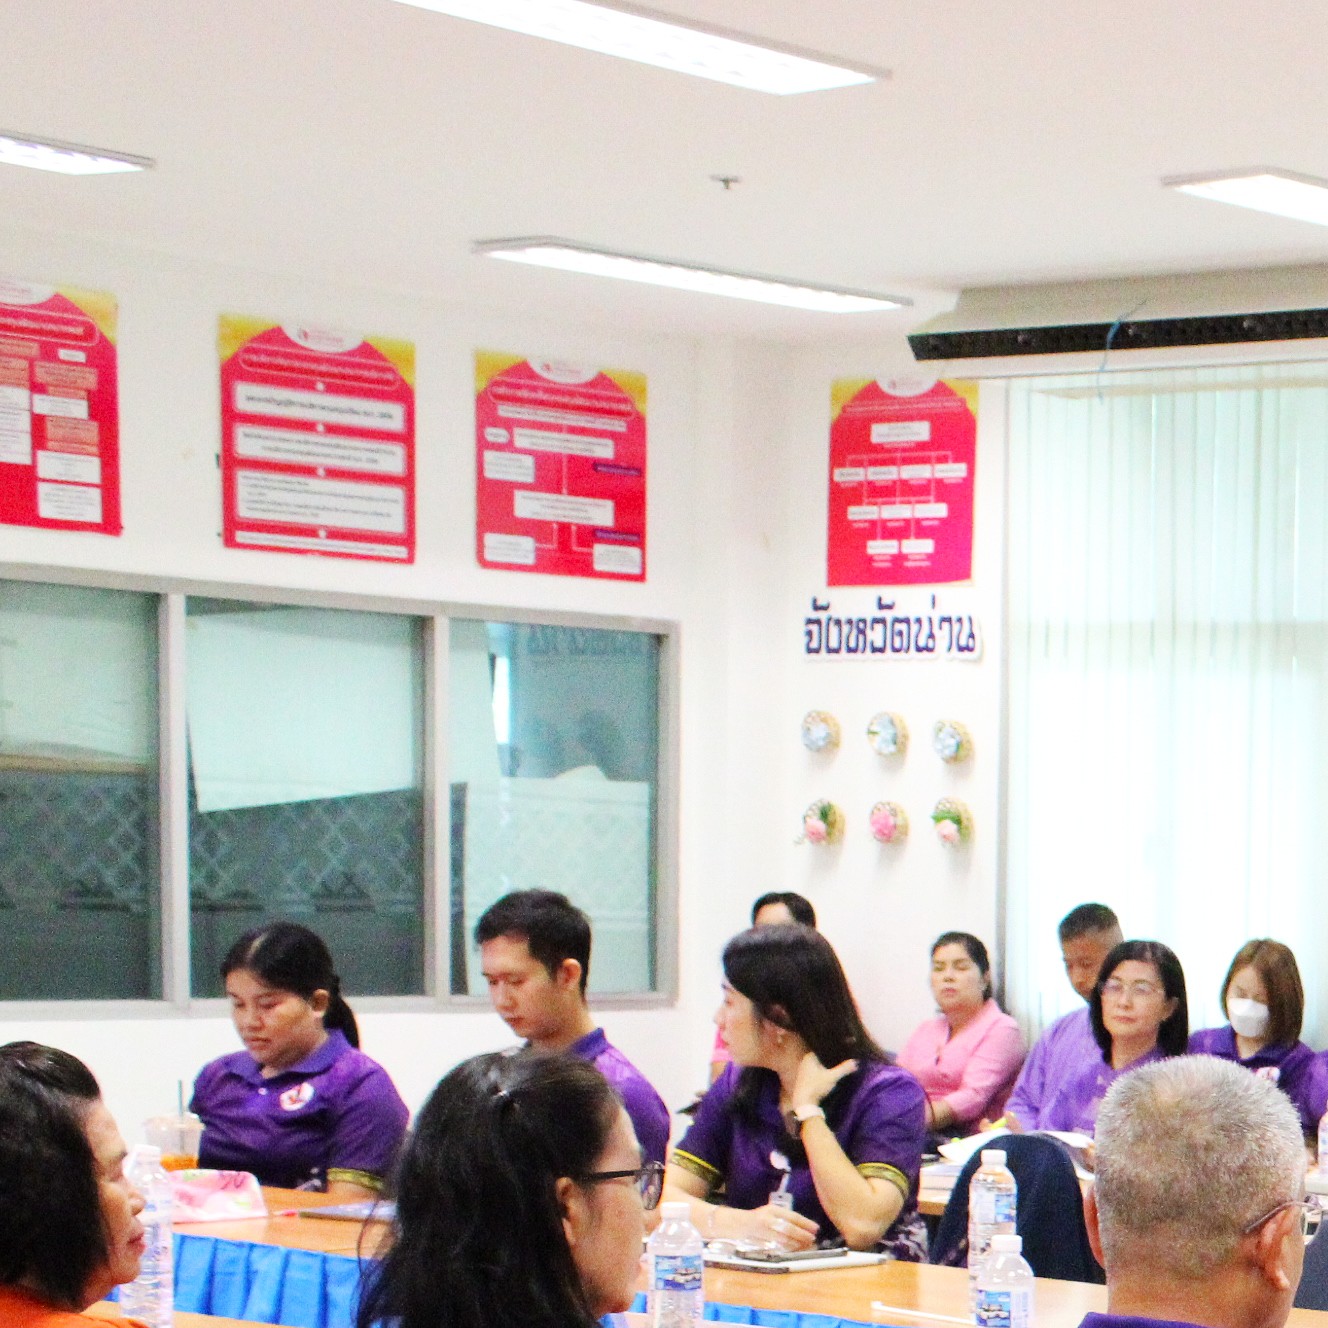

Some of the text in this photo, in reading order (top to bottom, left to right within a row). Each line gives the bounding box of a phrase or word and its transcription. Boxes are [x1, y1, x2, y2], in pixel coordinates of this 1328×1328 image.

[804, 593, 976, 653] จังหวัดน่าน
